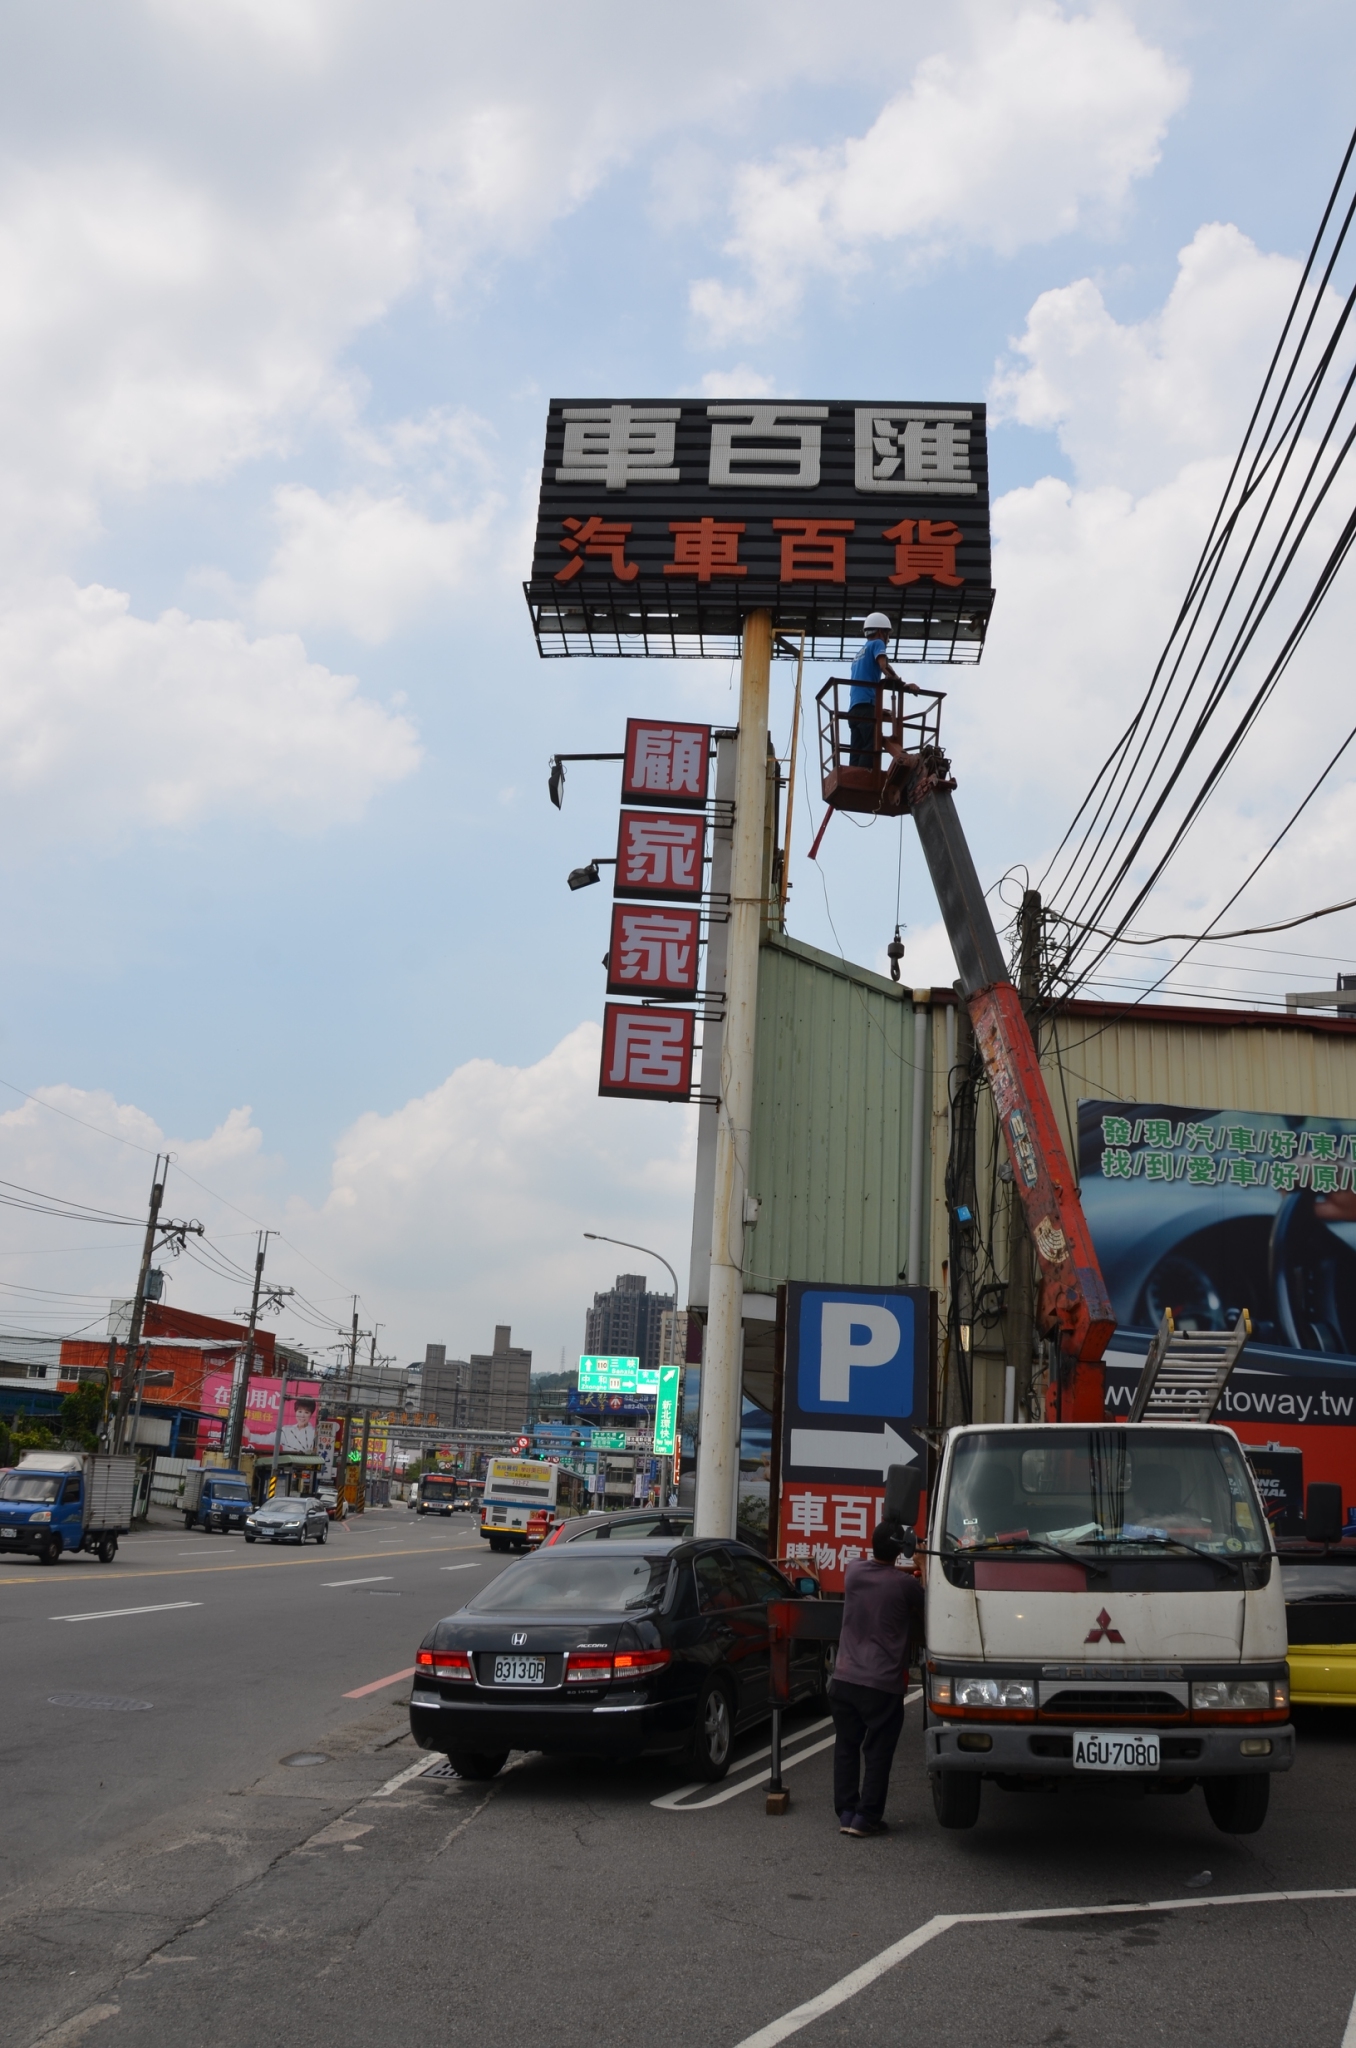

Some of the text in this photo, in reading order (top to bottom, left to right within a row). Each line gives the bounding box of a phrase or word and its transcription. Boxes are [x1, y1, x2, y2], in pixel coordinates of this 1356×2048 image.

[555, 404, 977, 495] 車百匯
[554, 516, 965, 587] 汽車百貨
[609, 729, 703, 1086] 顧家家居
[1101, 1148, 1356, 1193] 找/到/愛/車/好/原/
[820, 1302, 900, 1402] P
[214, 1385, 282, 1410] 在用心
[581, 1375, 607, 1384] 中和
[660, 1400, 672, 1438] 新北環快
[786, 1491, 890, 1539] 車百
[1042, 1666, 1184, 1680] CANTER
